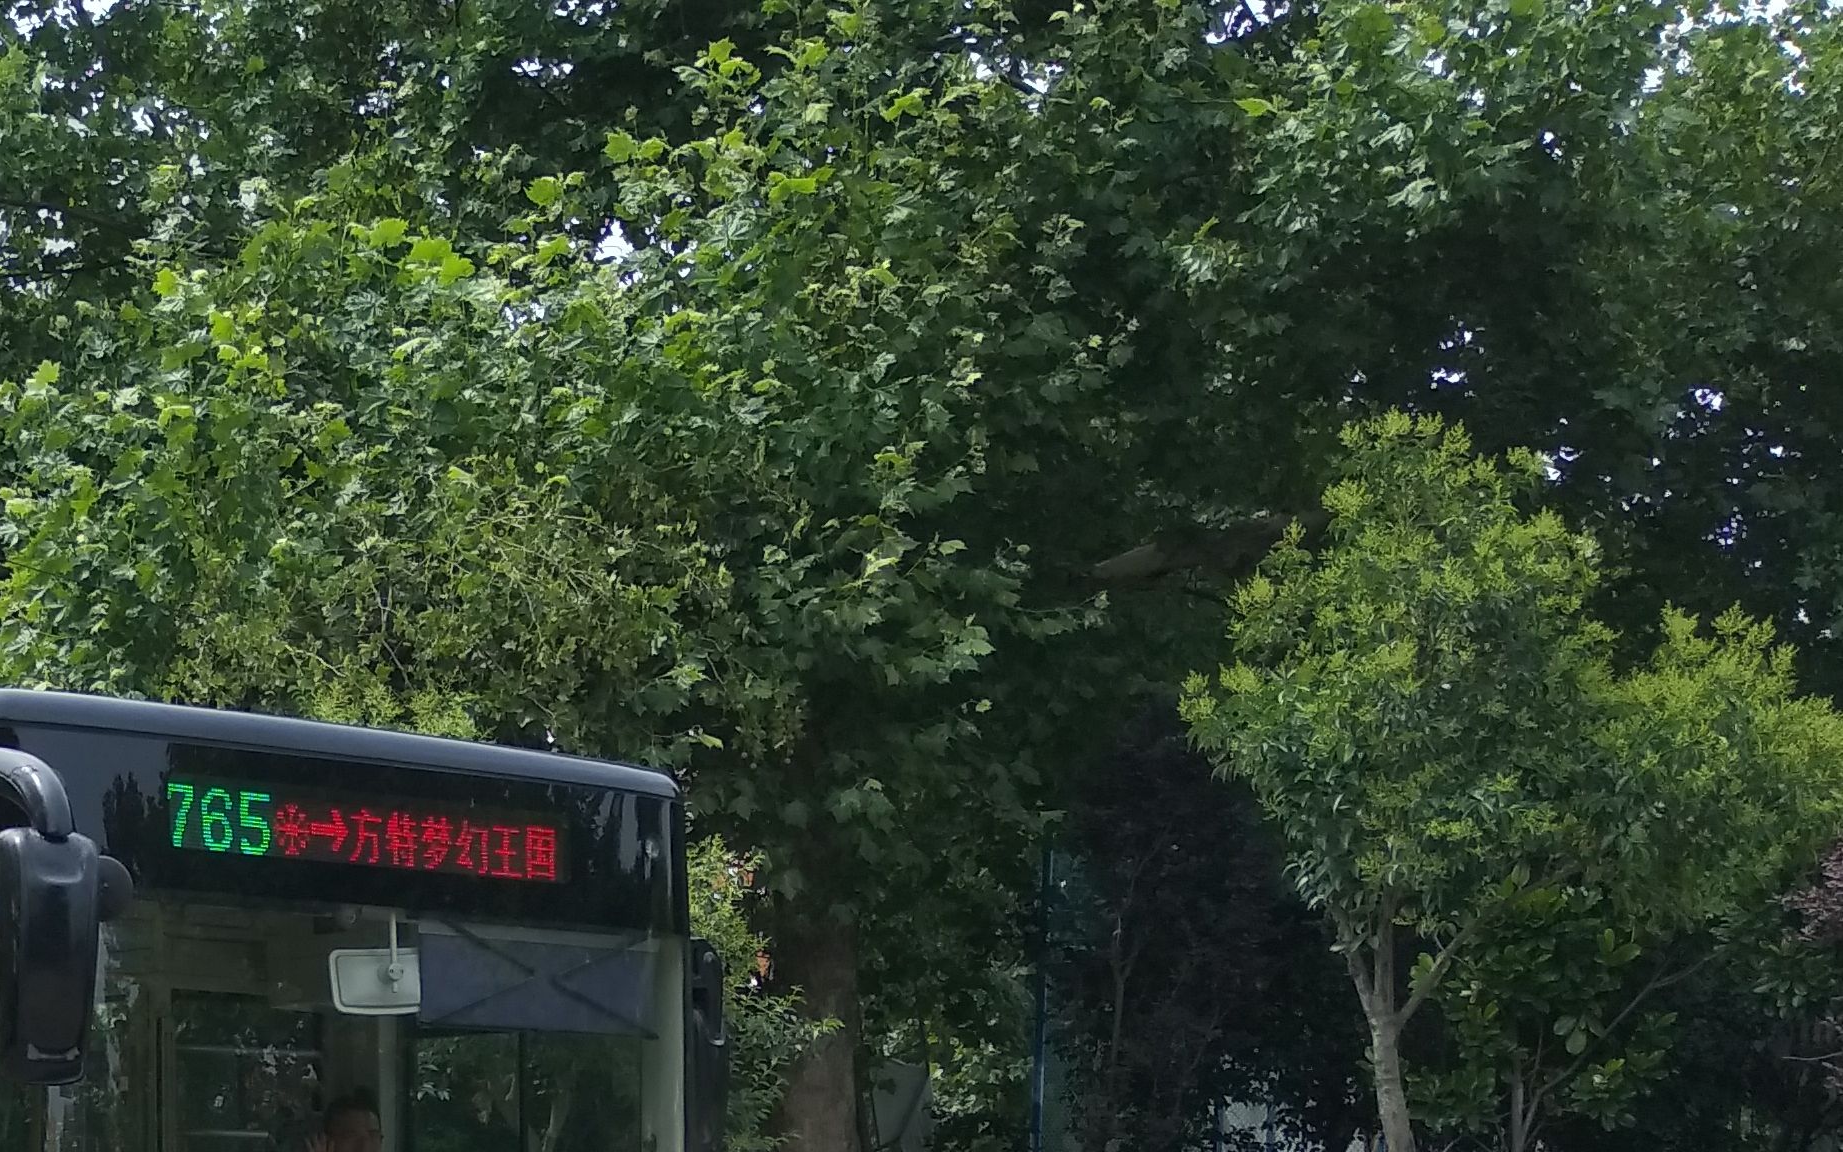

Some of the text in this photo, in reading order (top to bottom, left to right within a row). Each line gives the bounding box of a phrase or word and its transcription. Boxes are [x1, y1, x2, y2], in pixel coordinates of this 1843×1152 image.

[167, 782, 272, 856] 765
[349, 808, 556, 881] 方特梦幻王国
